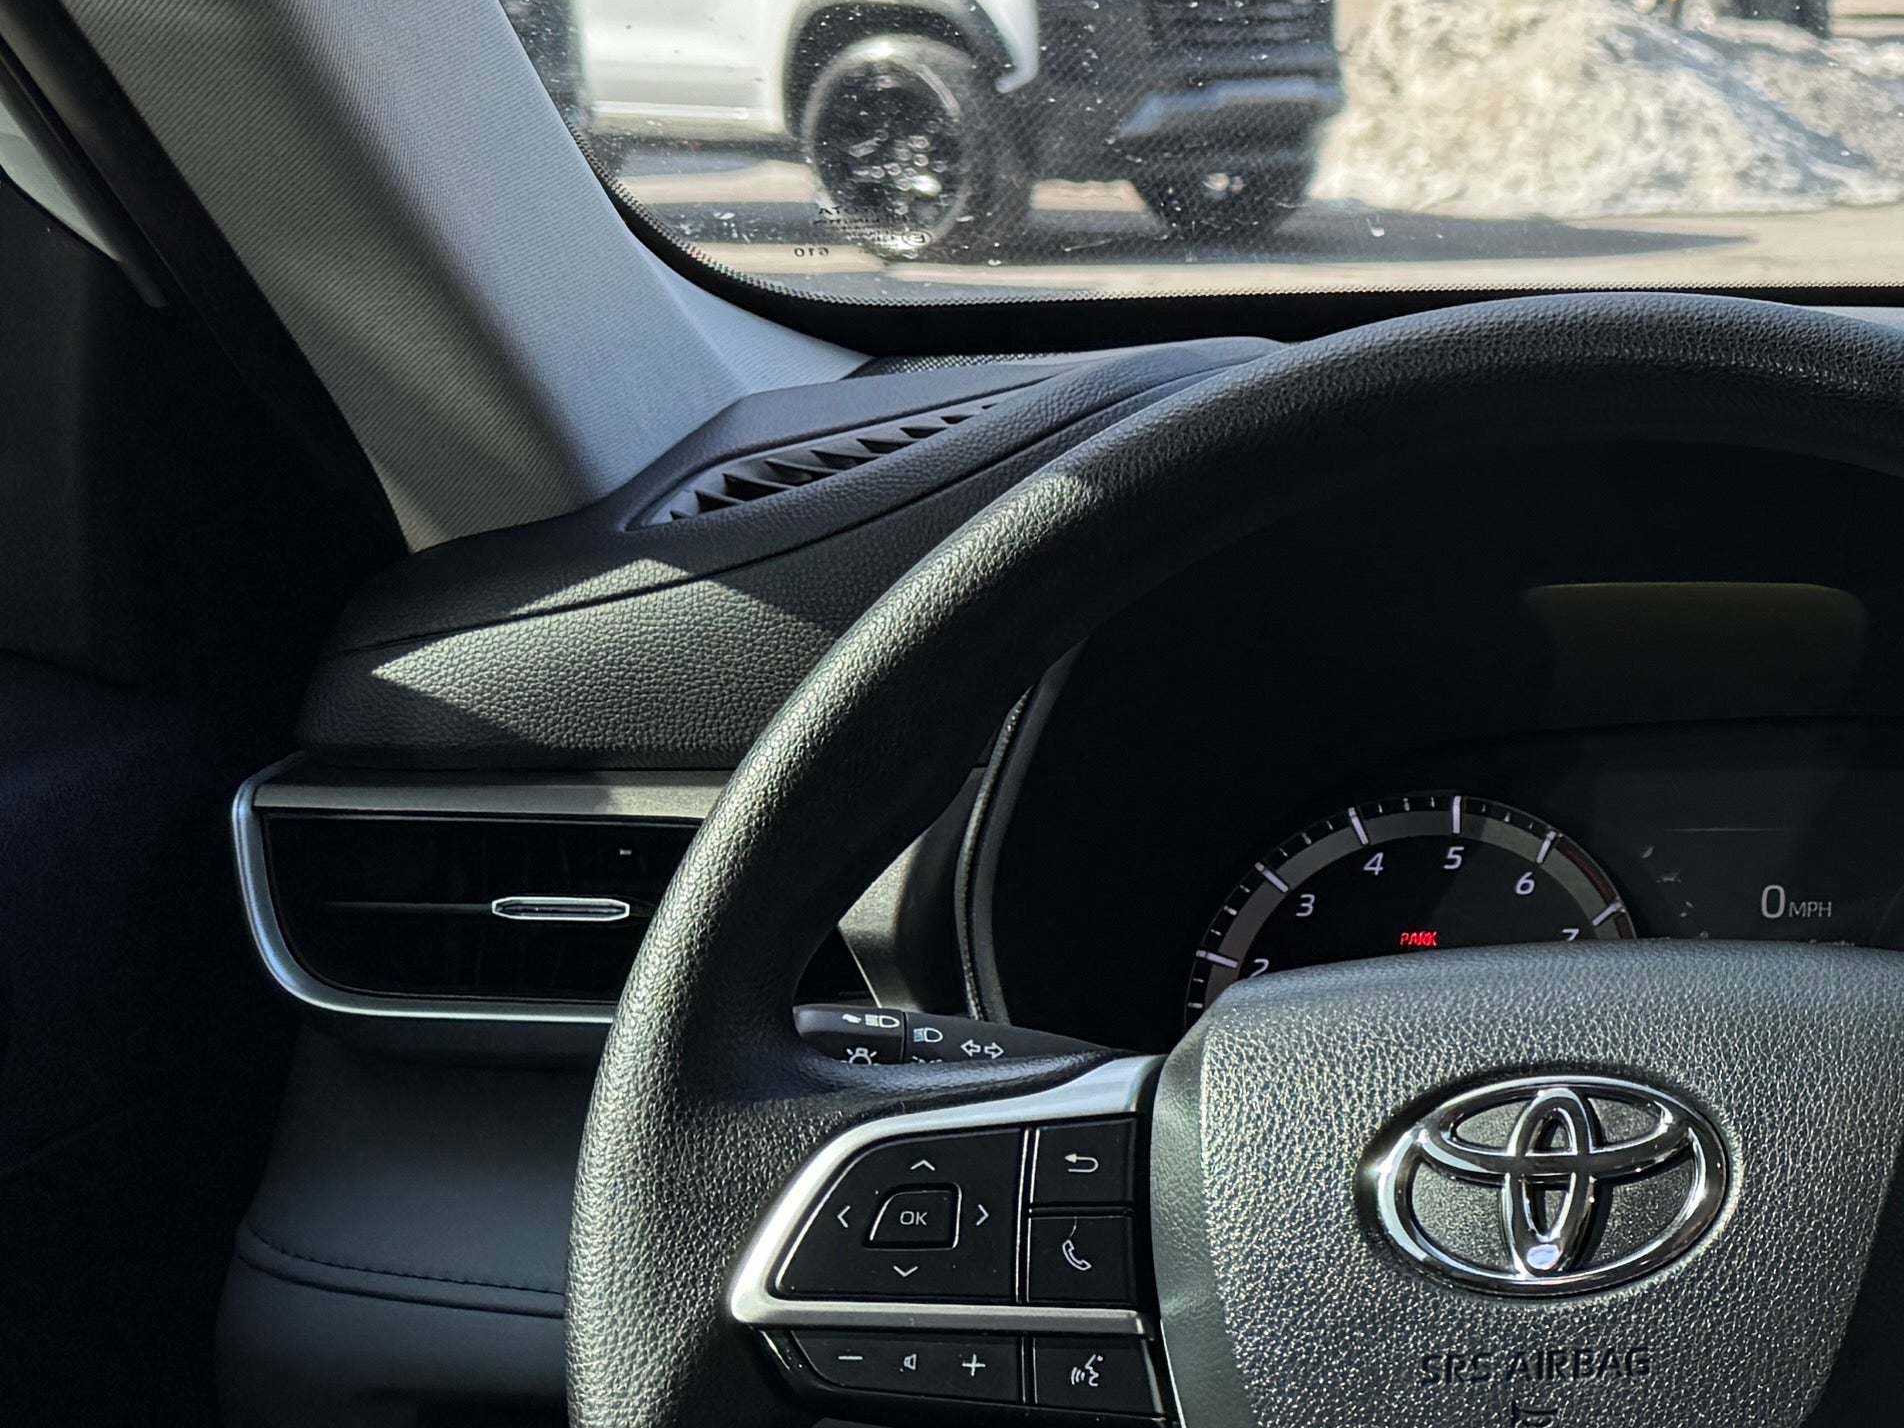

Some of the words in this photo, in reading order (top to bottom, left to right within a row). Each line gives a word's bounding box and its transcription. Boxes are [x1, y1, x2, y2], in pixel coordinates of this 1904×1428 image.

[1363, 852, 1384, 876] 4
[1443, 846, 1465, 870] 5
[1514, 872, 1535, 896] 6
[1296, 894, 1316, 917] 3
[1760, 884, 1786, 920] 0
[1788, 900, 1832, 919] MPH
[900, 1211, 927, 1226] OK
[1419, 1353, 1494, 1387] SRS
[1502, 1345, 1654, 1383] AIRBAG
